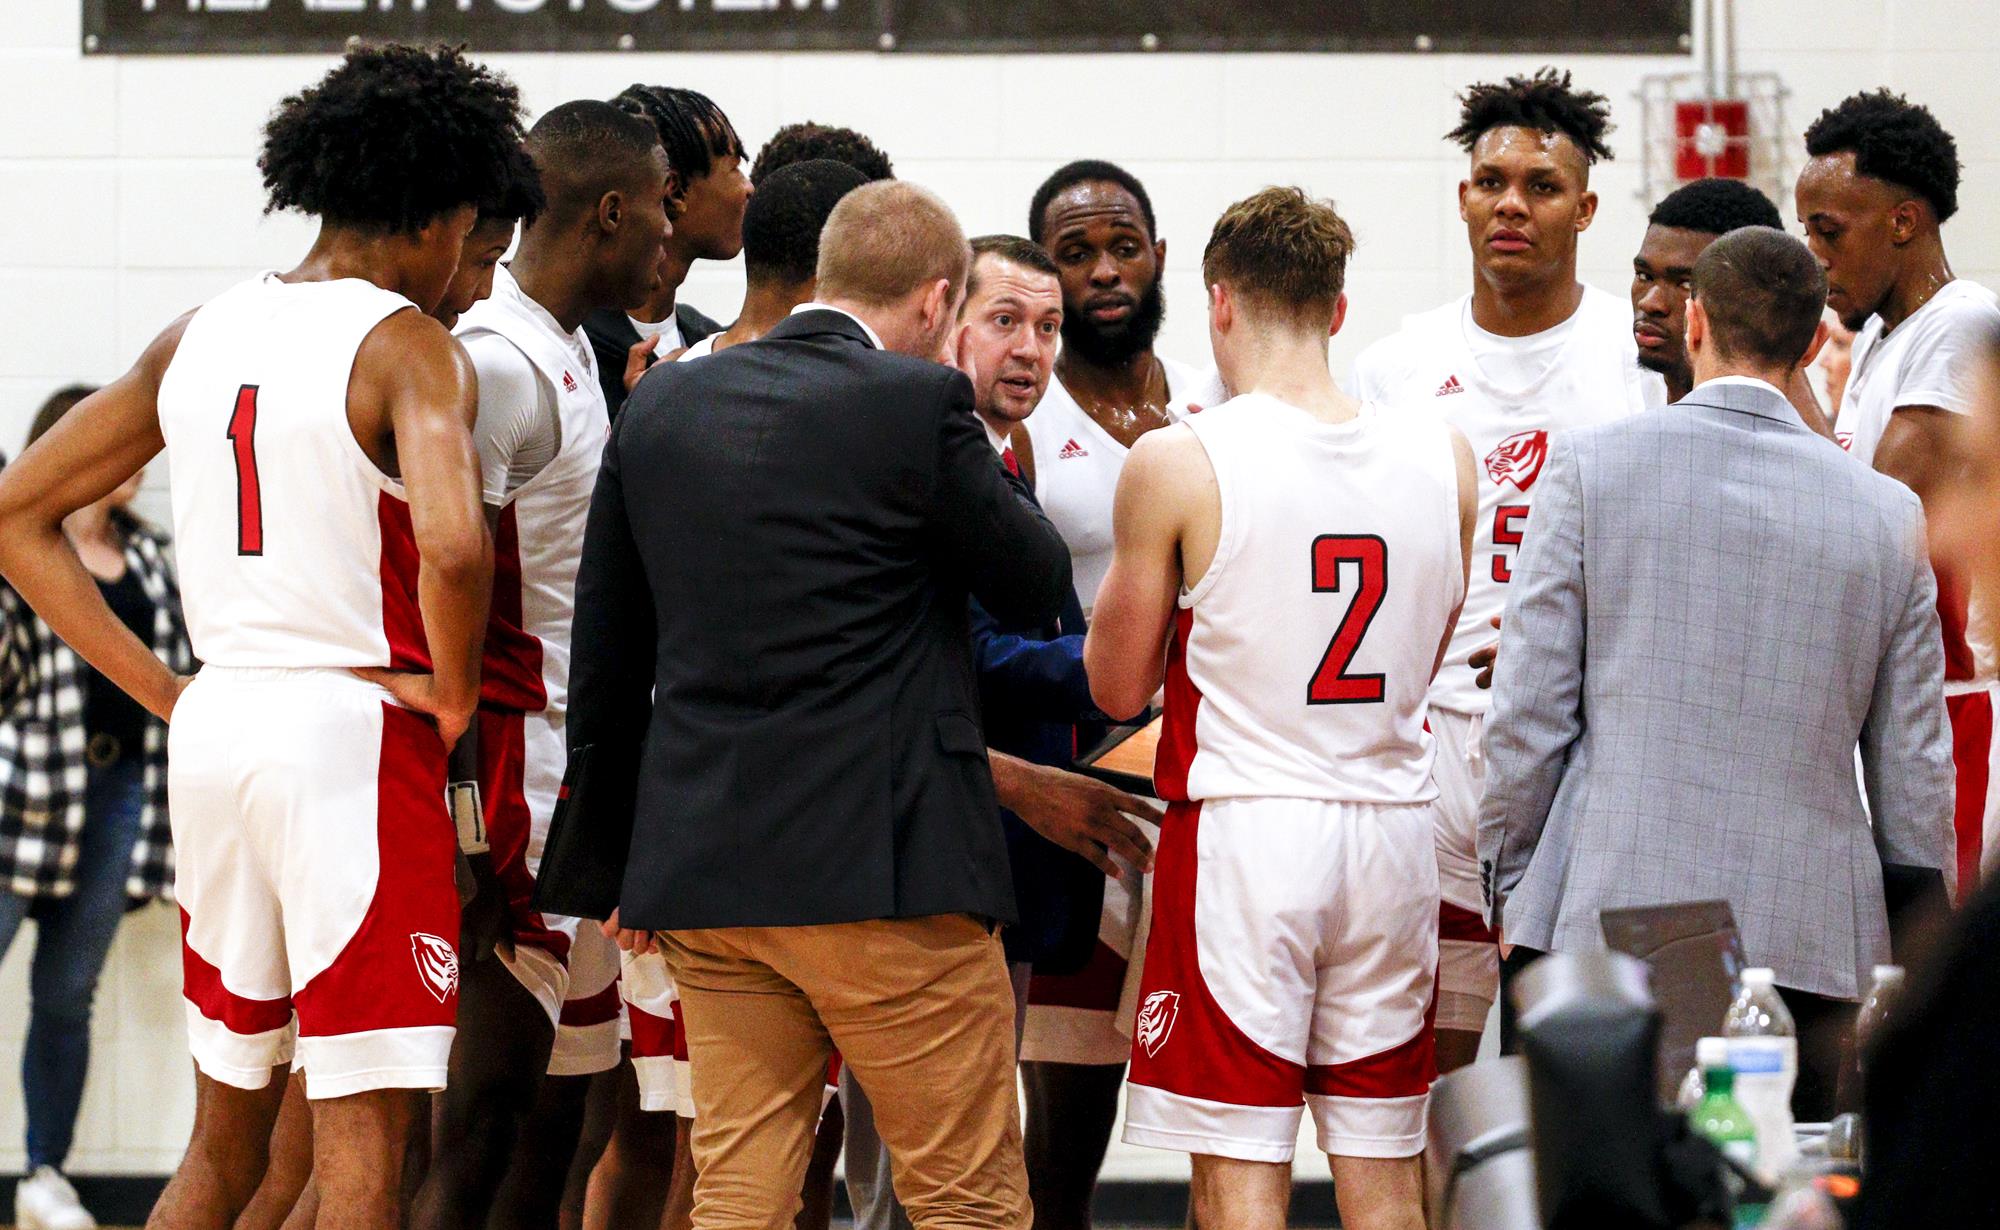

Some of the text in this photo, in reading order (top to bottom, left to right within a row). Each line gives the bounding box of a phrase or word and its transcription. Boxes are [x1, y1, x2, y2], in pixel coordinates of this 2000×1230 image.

[227, 384, 263, 556] 1
[1491, 505, 1530, 583] 5
[1306, 534, 1388, 705] 2
